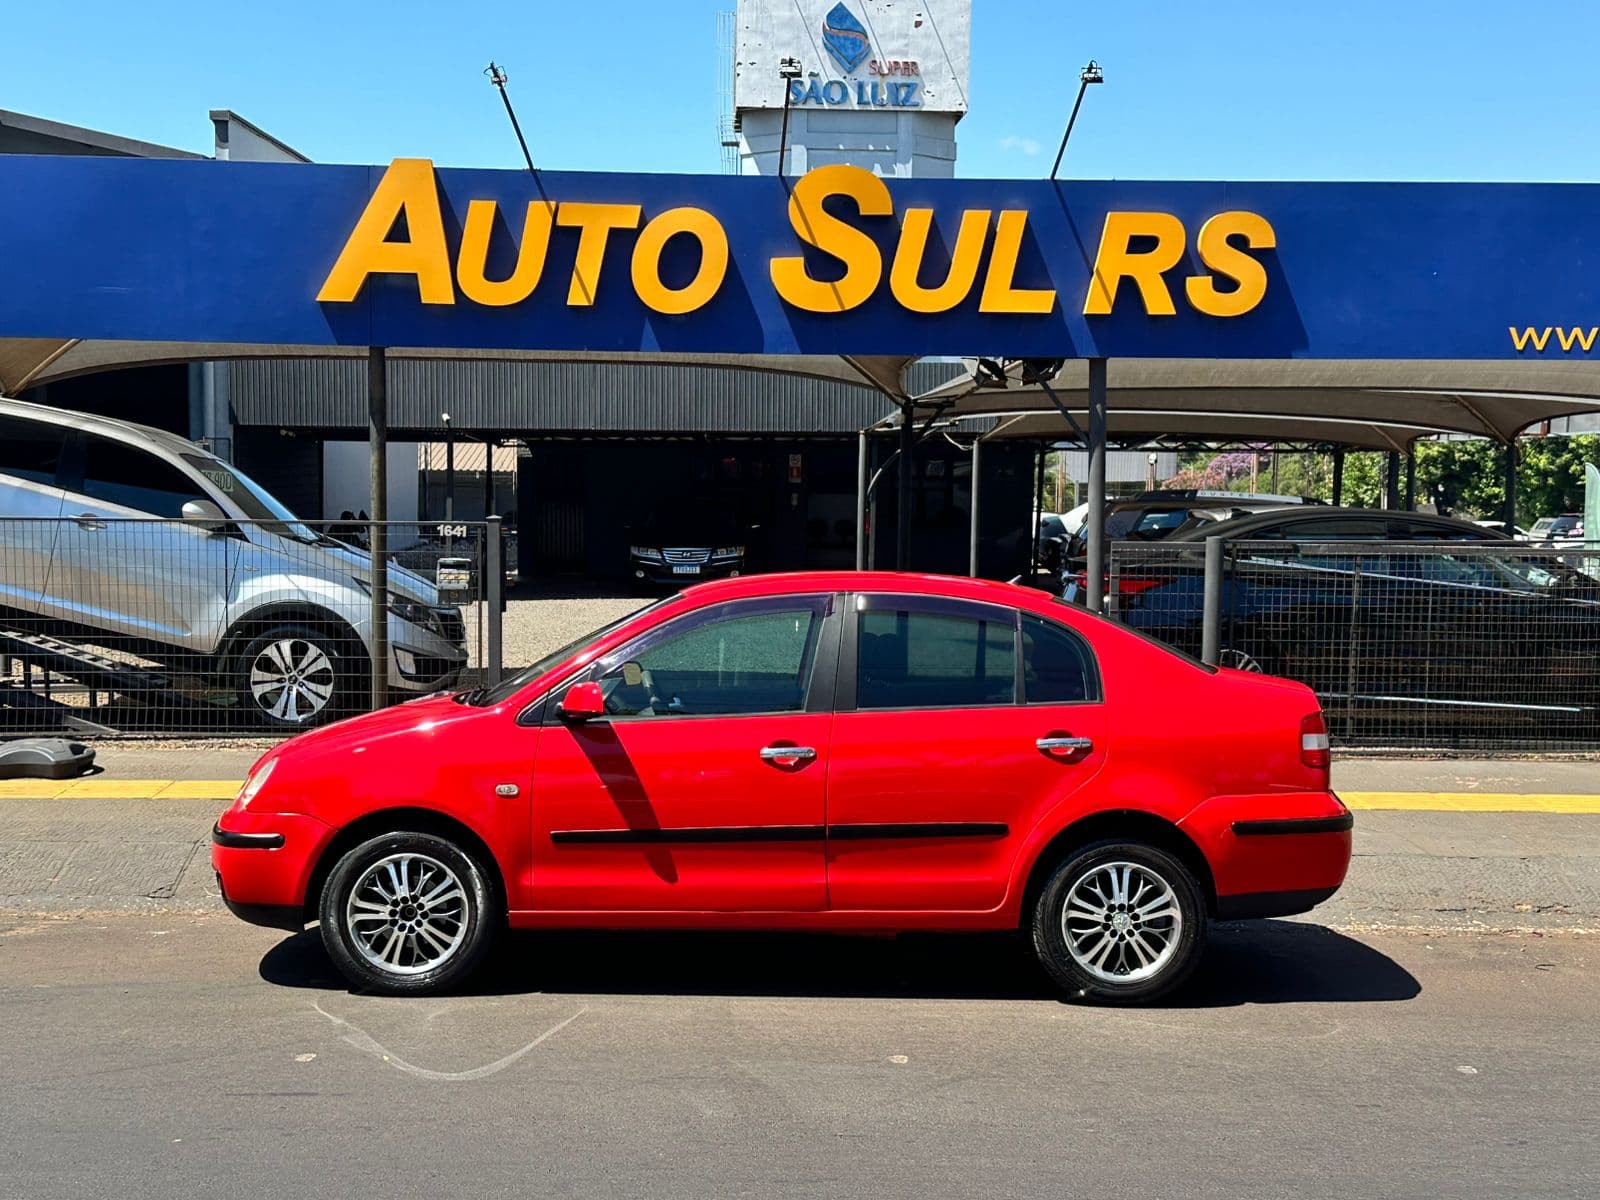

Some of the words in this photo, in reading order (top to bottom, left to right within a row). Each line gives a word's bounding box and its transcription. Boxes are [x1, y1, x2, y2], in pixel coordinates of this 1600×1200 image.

[869, 59, 919, 76] SUPER
[790, 71, 849, 105] SÃO
[857, 80, 920, 106] LUIZ
[316, 158, 729, 314] AUTO
[769, 164, 1056, 313] SUL
[1083, 211, 1276, 317] RS
[437, 524, 467, 538] 1641
